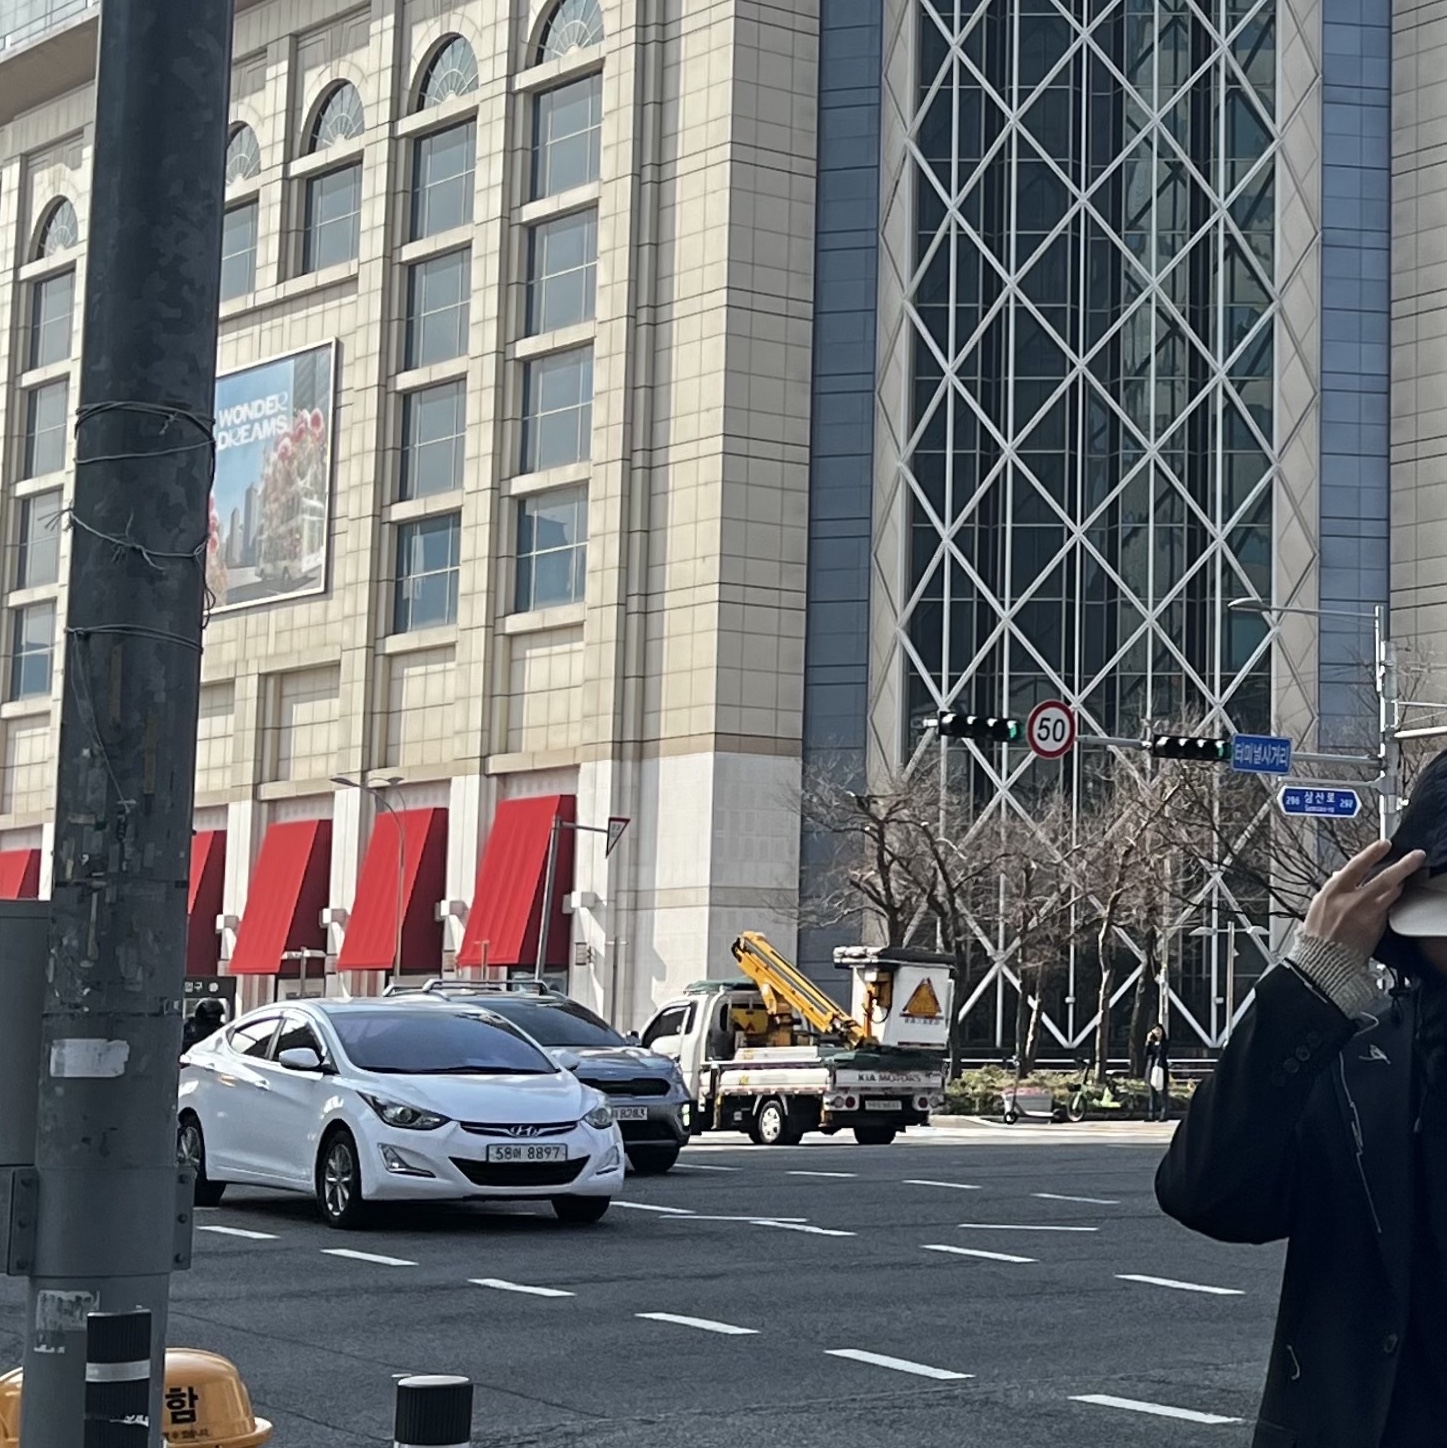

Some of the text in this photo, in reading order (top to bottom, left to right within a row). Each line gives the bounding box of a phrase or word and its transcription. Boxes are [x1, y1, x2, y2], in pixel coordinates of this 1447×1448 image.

[219, 391, 289, 428] WONDER
[217, 414, 288, 450] DREAMS
[1037, 717, 1065, 742] 50
[1235, 742, 1289, 768] 터미널사거리
[527, 1146, 561, 1161] 8897
